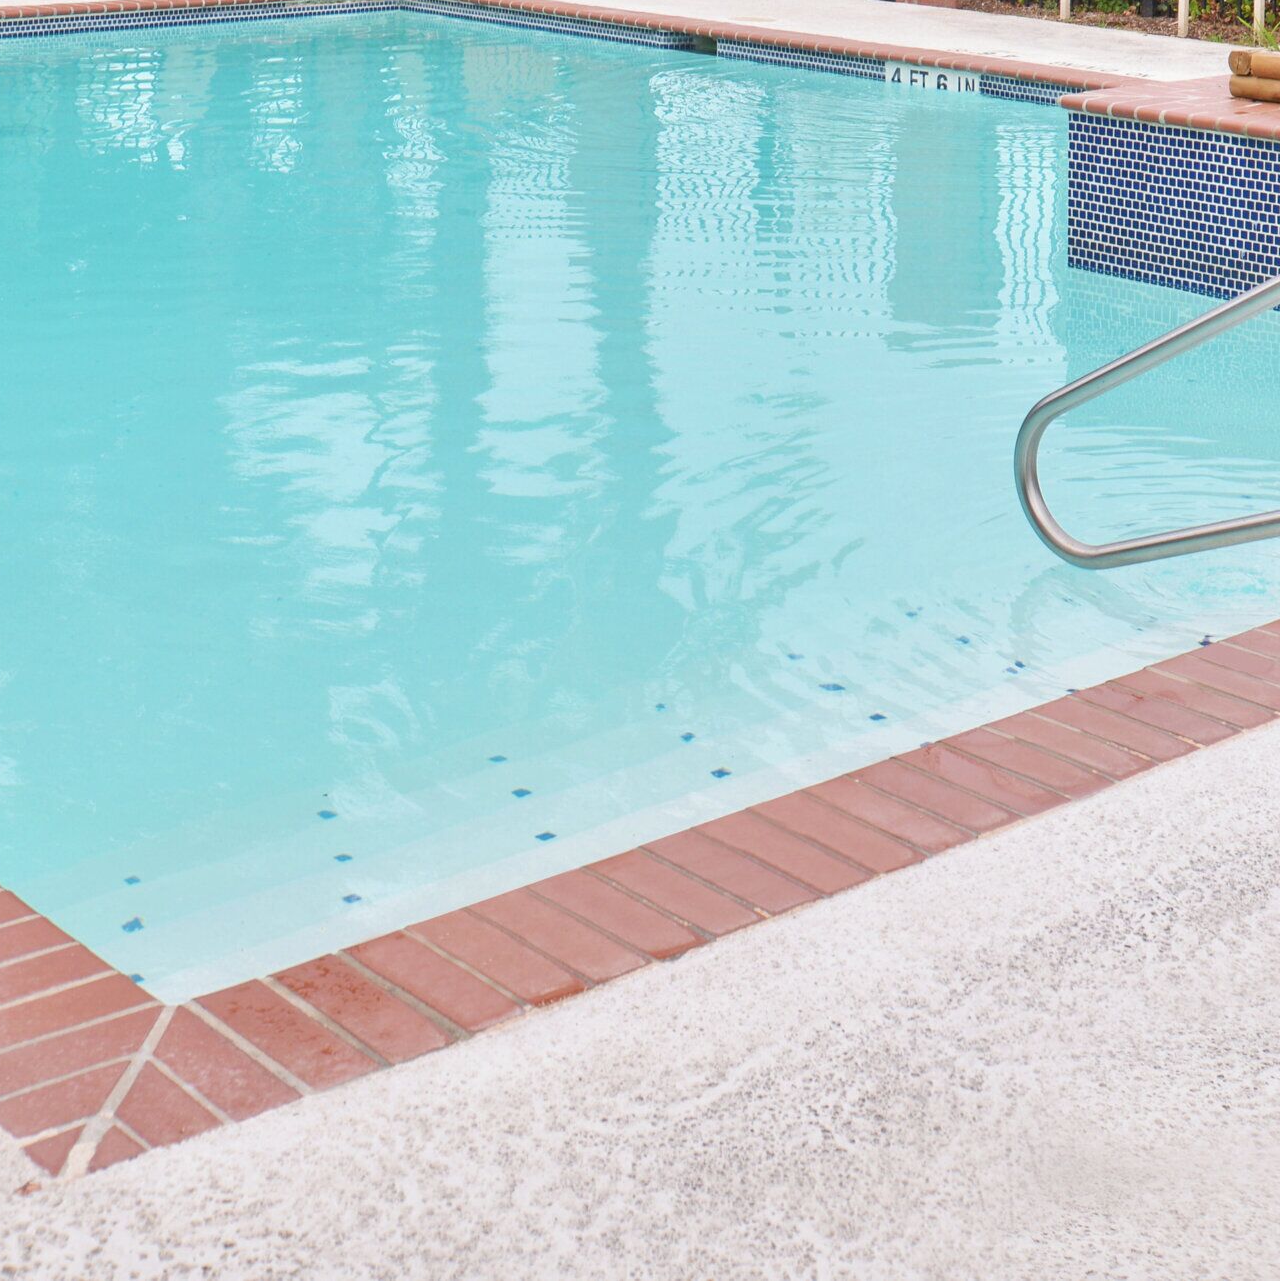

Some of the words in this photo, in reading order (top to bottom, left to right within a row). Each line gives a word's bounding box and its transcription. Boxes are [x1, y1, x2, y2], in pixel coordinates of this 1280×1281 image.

[891, 67, 901, 83] 4
[910, 70, 929, 88] FT
[936, 74, 948, 90] 6
[958, 77, 975, 92] IN
